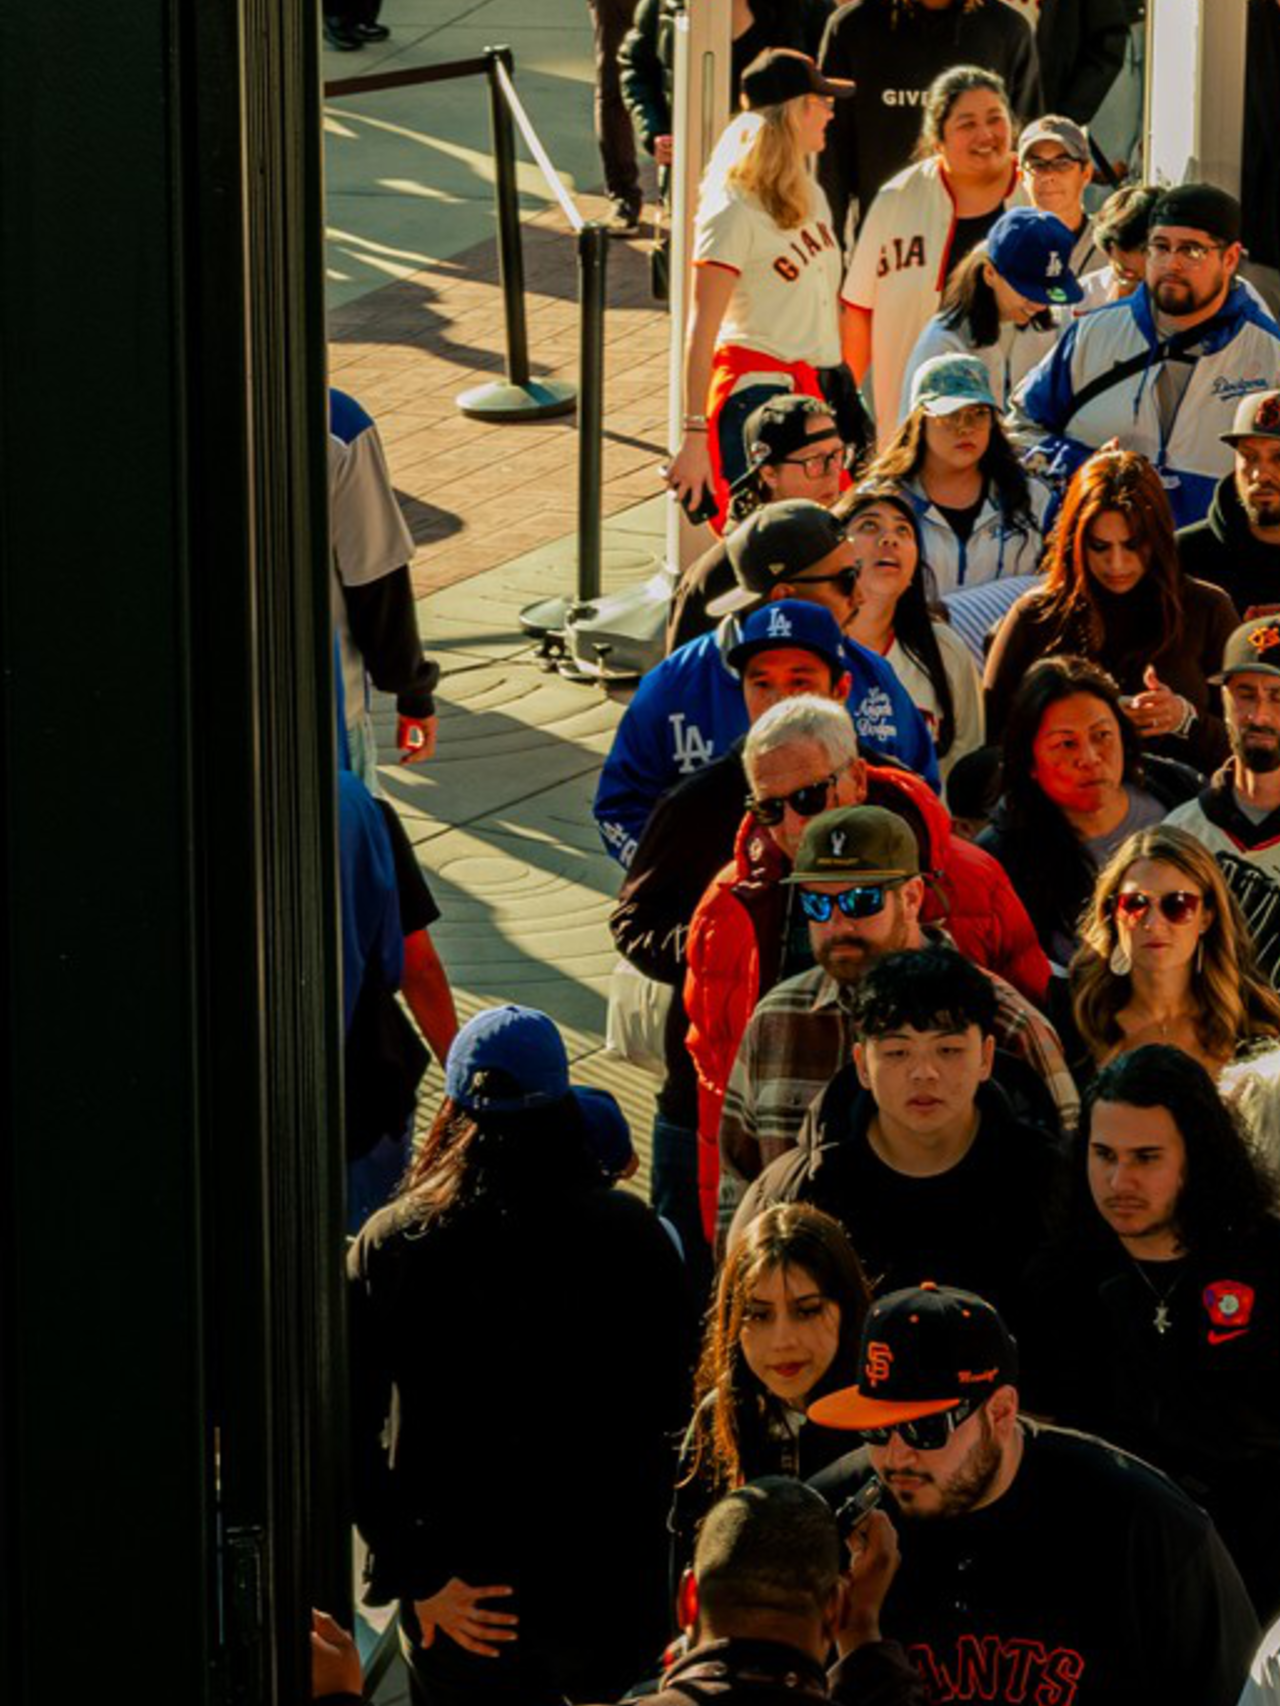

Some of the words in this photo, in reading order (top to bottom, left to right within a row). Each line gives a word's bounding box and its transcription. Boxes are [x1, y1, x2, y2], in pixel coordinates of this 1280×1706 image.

[765, 606, 794, 638] LA
[668, 712, 715, 774] LA
[866, 1340, 895, 1388] SF
